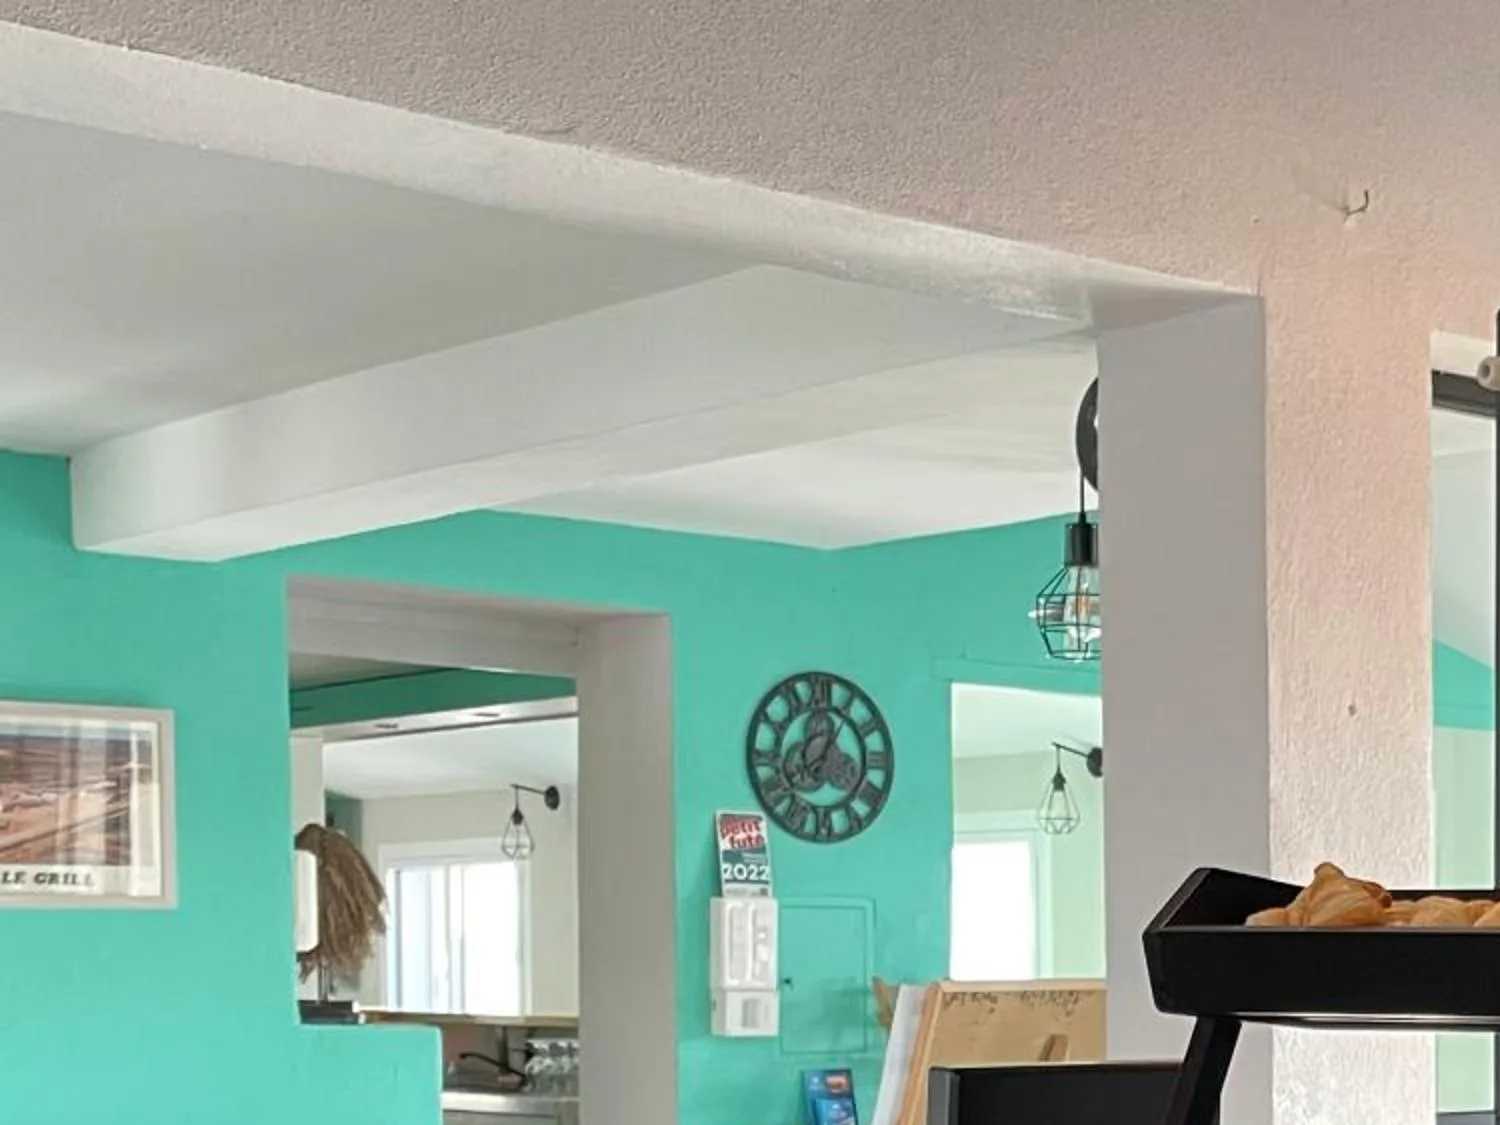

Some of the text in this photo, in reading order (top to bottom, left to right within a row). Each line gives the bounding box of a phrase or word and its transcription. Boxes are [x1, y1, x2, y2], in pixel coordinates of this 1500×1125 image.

[1, 870, 96, 887] LE GRILL
[721, 863, 770, 881] 2022
